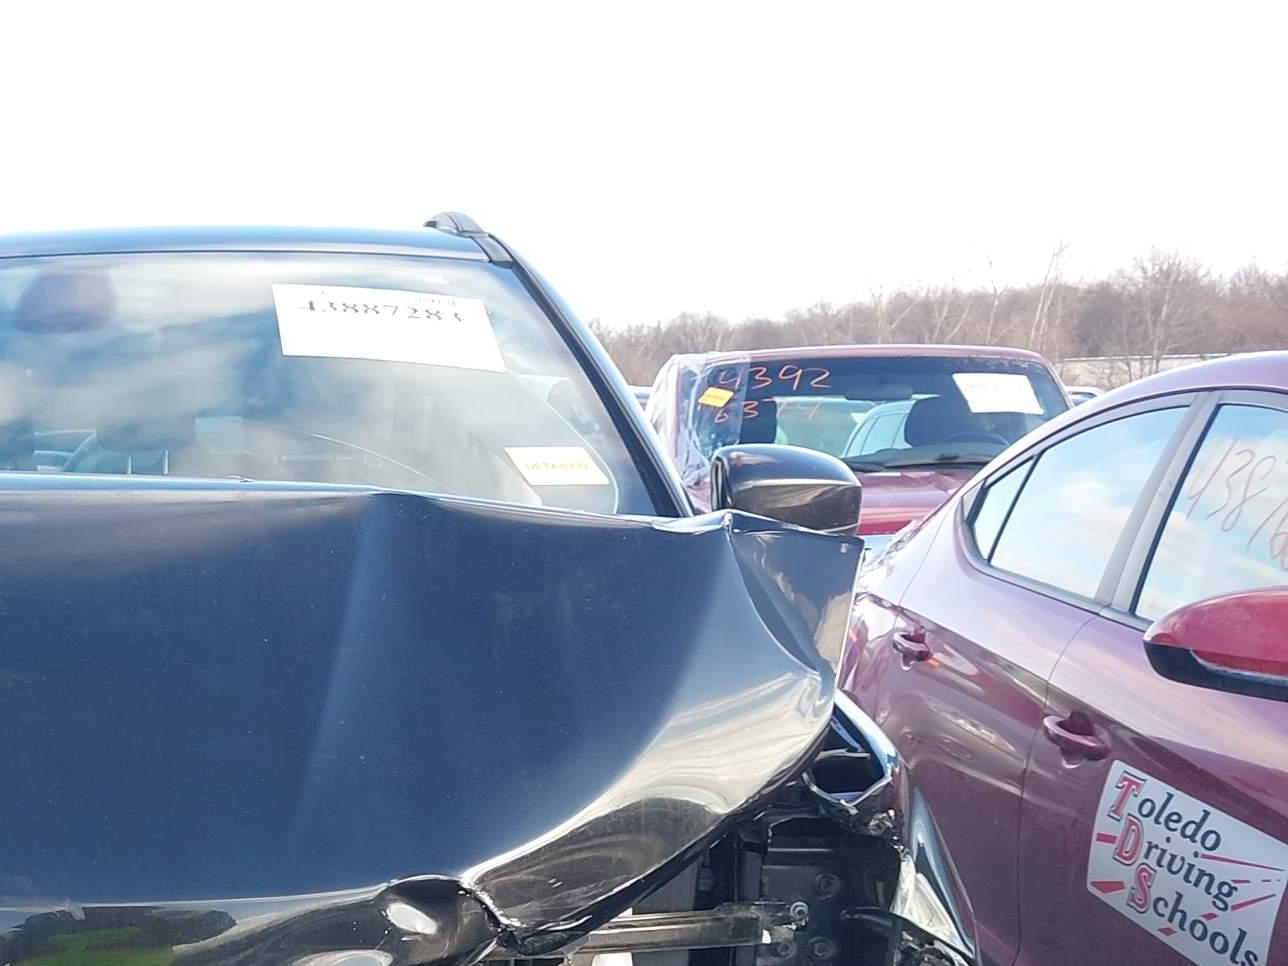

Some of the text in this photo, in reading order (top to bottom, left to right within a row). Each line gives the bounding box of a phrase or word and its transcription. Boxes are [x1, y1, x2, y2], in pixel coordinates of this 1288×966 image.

[717, 363, 832, 391] 4392
[1107, 770, 1222, 852] Toledo
[1112, 816, 1239, 912] Driving
